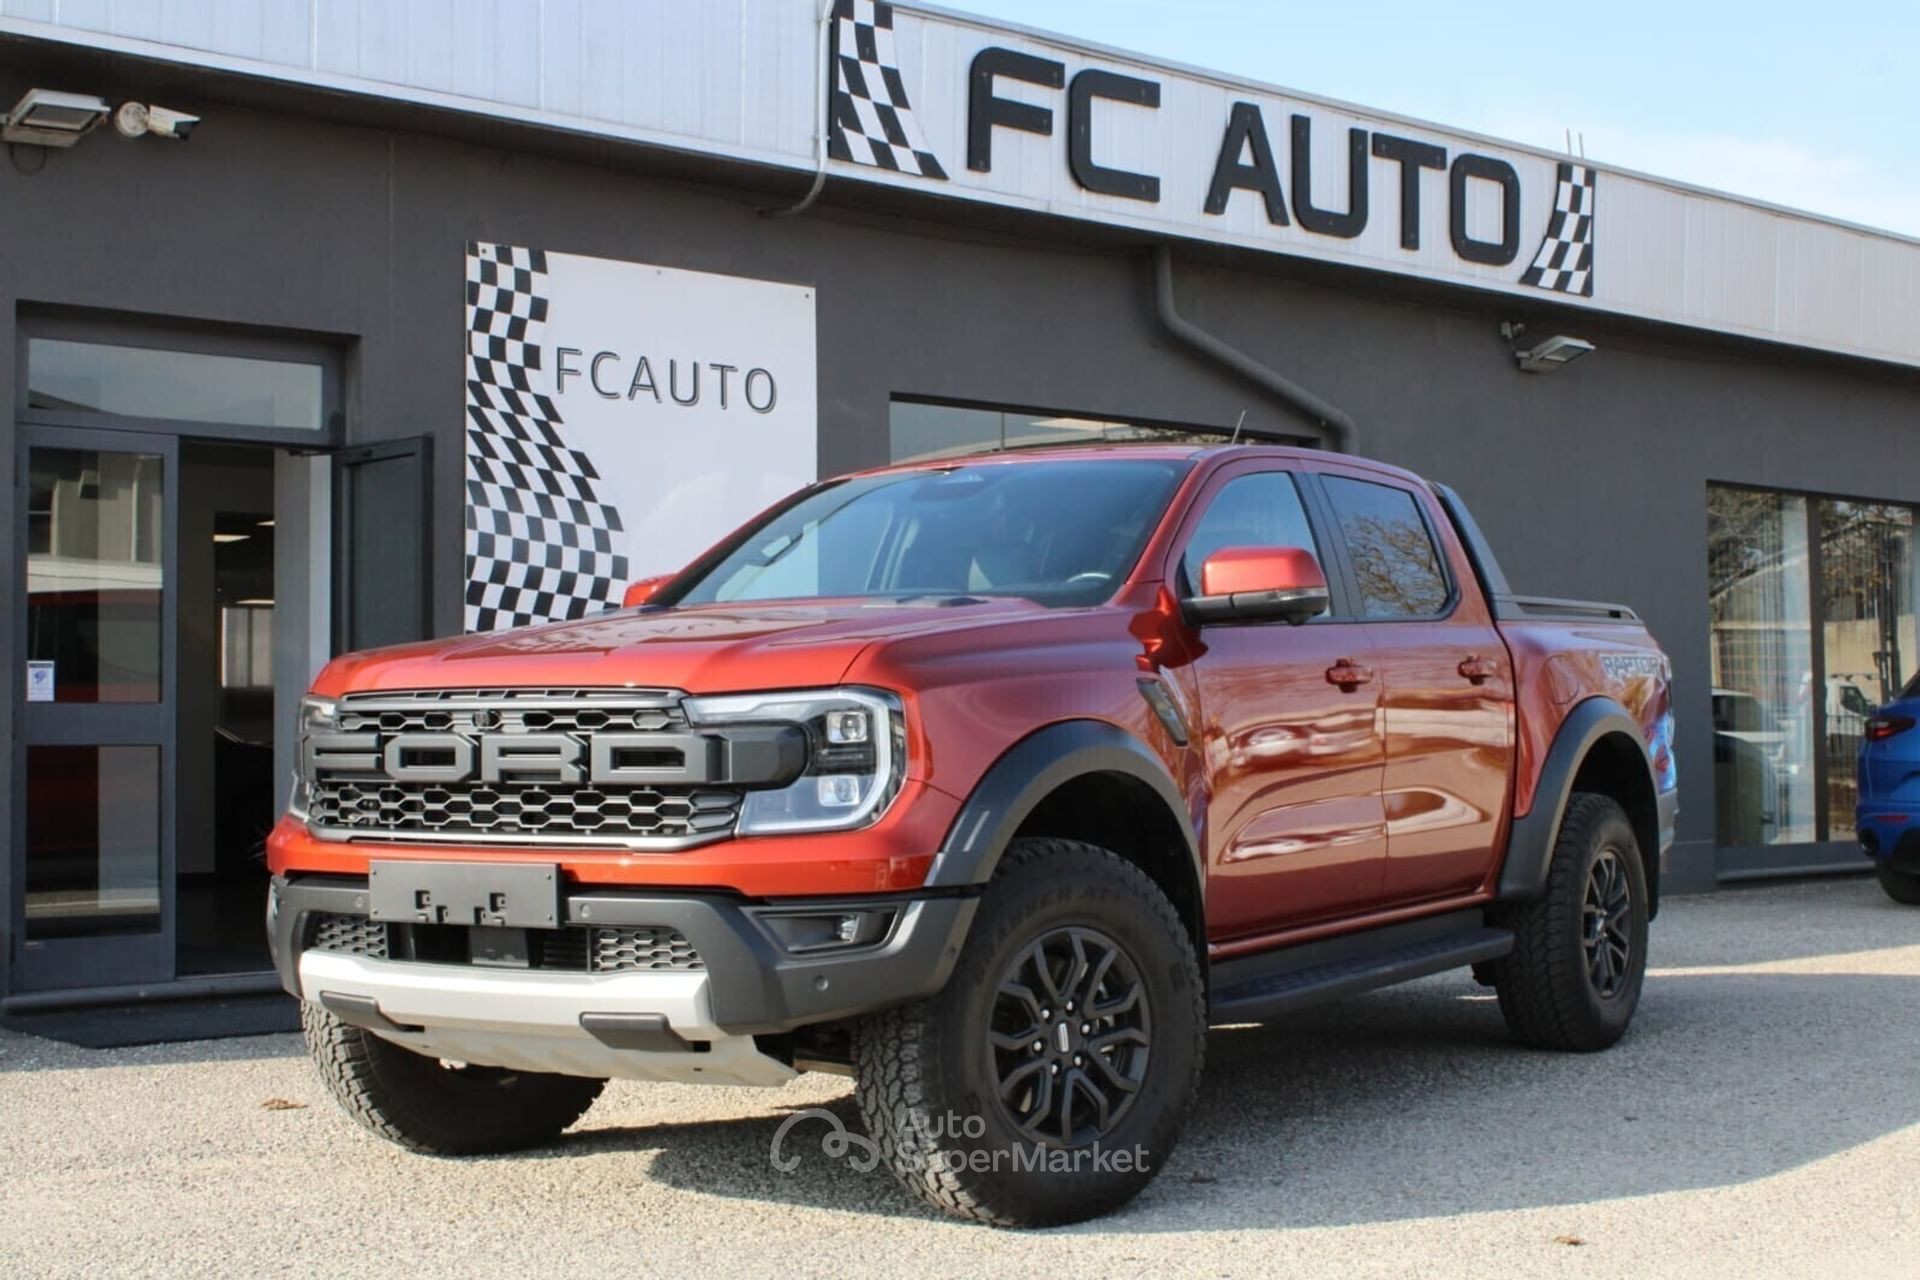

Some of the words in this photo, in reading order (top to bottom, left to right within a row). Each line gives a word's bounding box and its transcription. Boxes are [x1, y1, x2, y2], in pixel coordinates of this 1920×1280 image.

[967, 46, 1161, 203] FC
[1203, 101, 1521, 267] AUTO
[555, 346, 777, 414] FCAUTO
[302, 732, 712, 783] FORD
